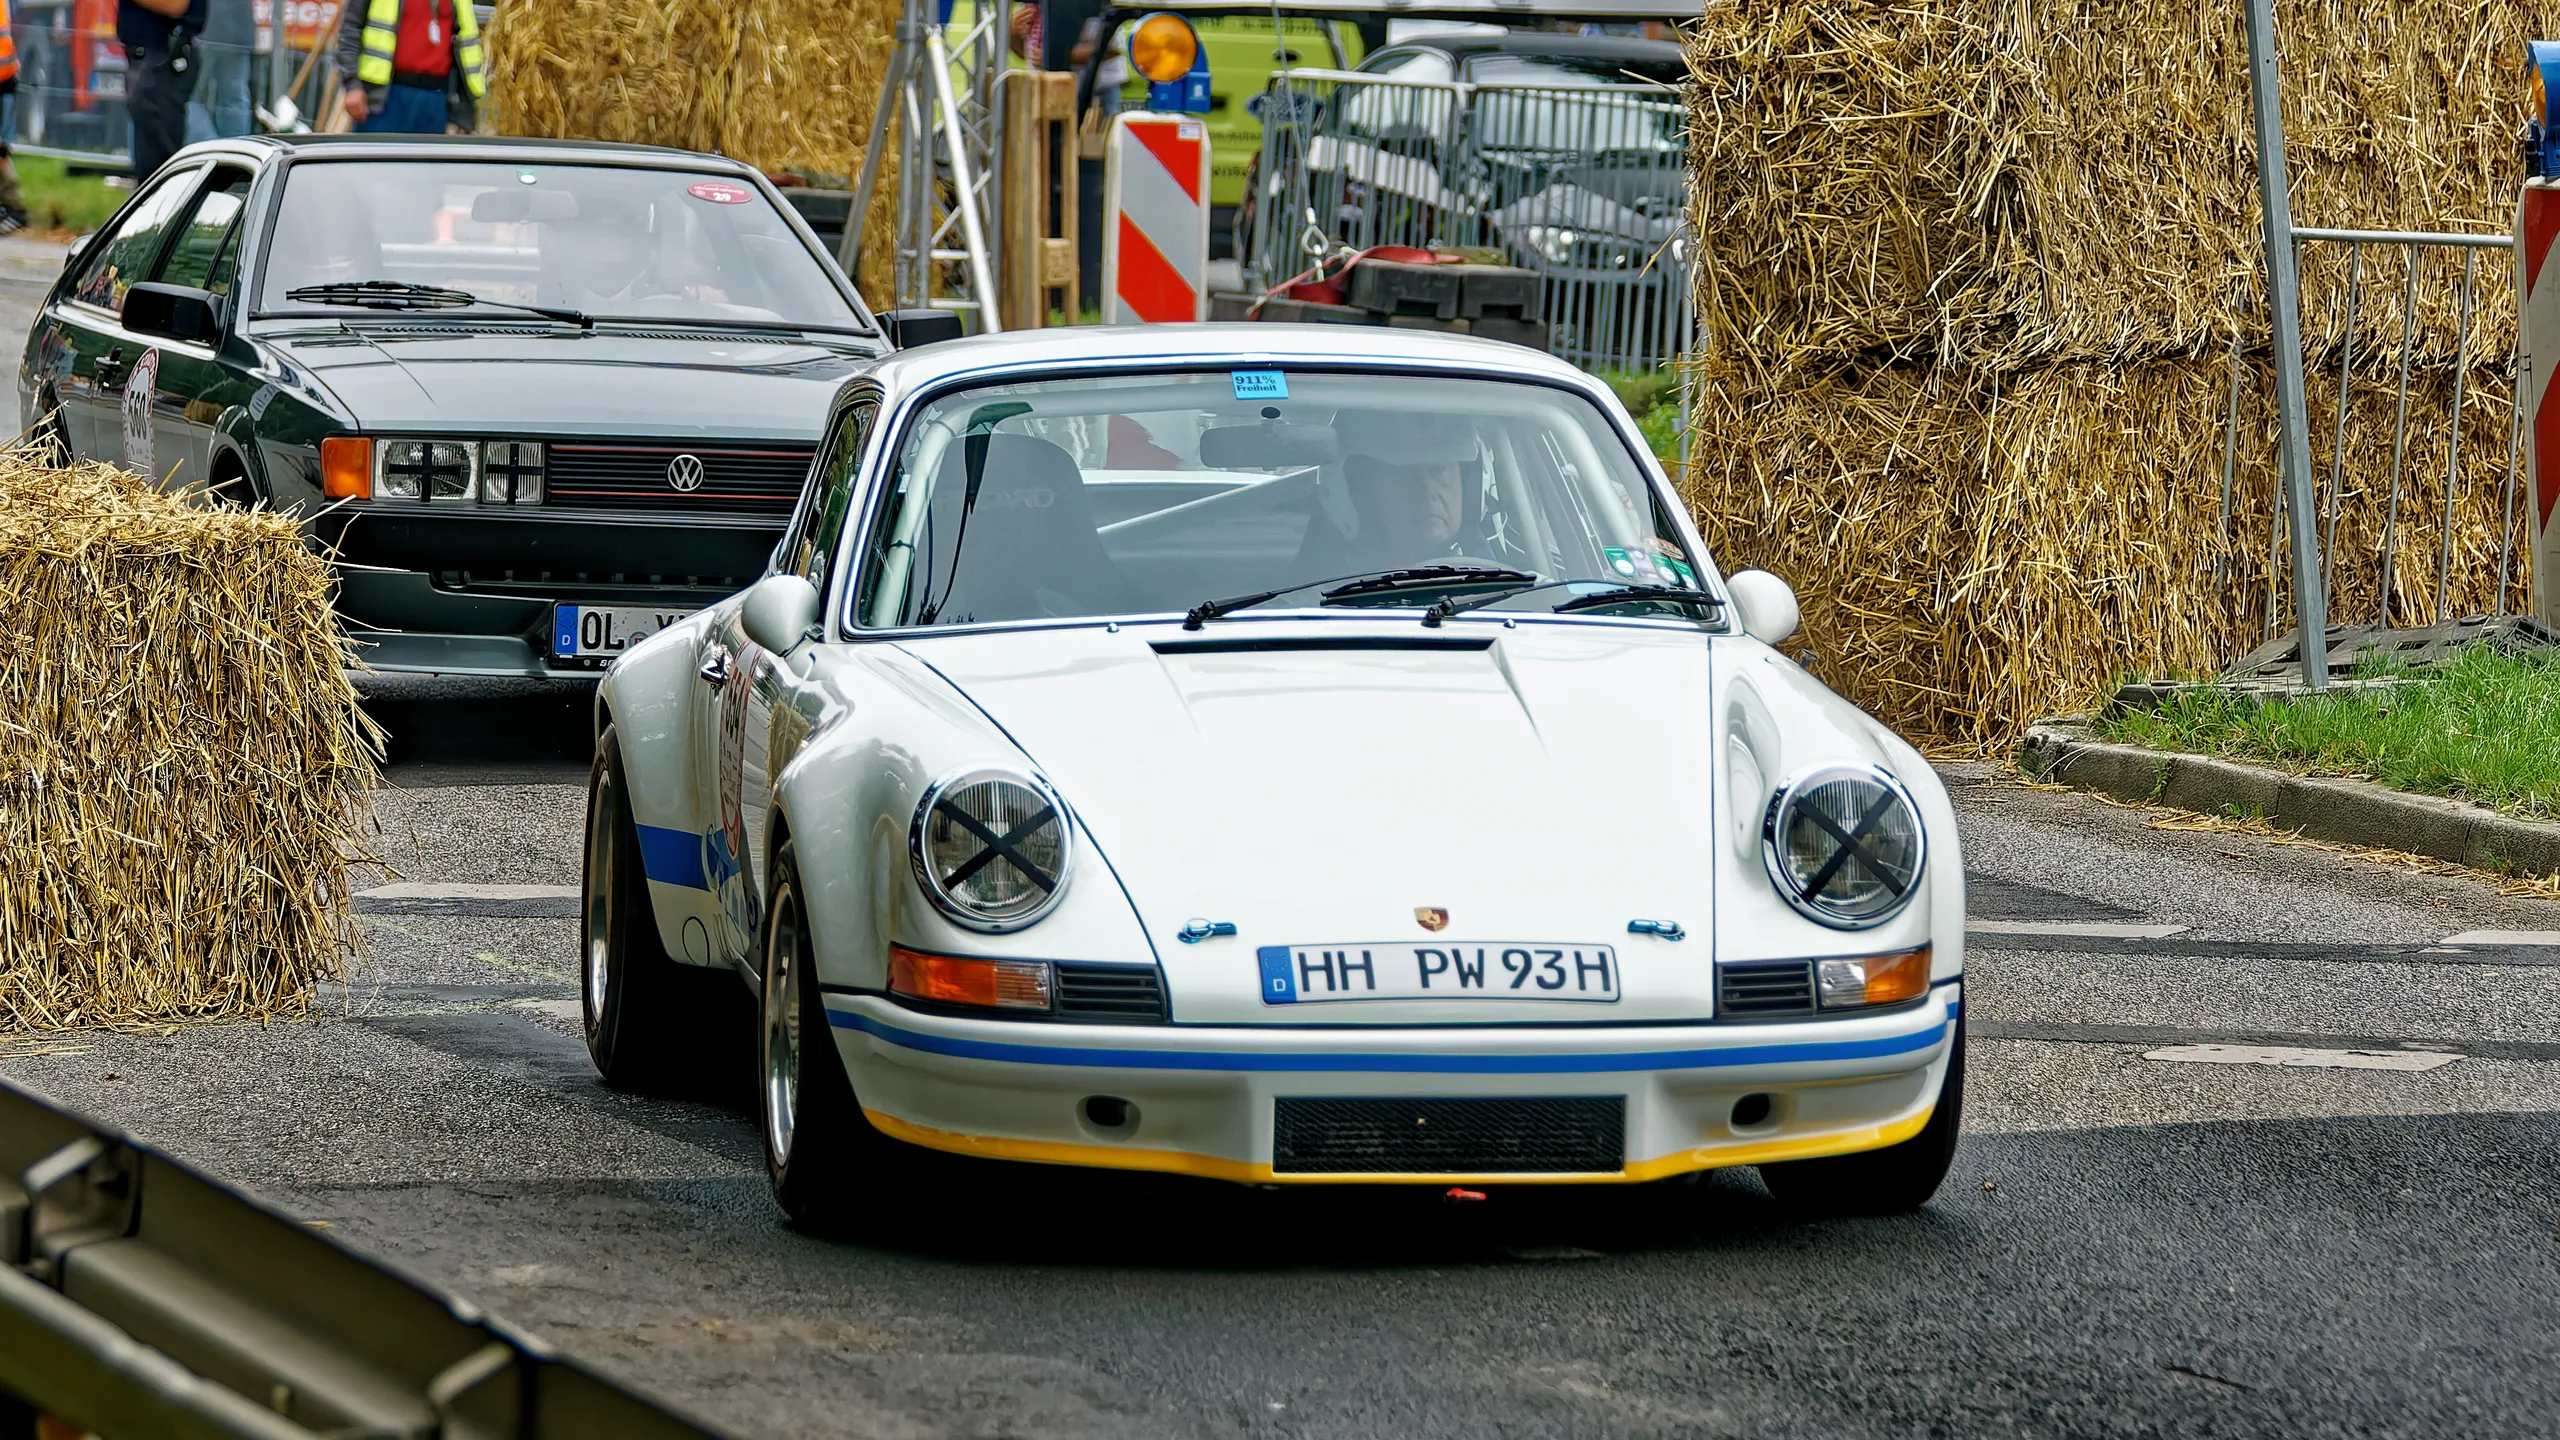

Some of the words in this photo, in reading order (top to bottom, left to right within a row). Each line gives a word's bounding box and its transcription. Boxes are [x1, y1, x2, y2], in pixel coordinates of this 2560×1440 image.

[1235, 375, 1276, 384] 911%
[1237, 384, 1277, 392] Freiheit
[562, 634, 571, 646] D
[581, 611, 624, 650] OL
[1273, 978, 1287, 992] D
[1297, 950, 1376, 992] HH
[1413, 948, 1485, 989] PW
[1501, 948, 1611, 992] 93H
